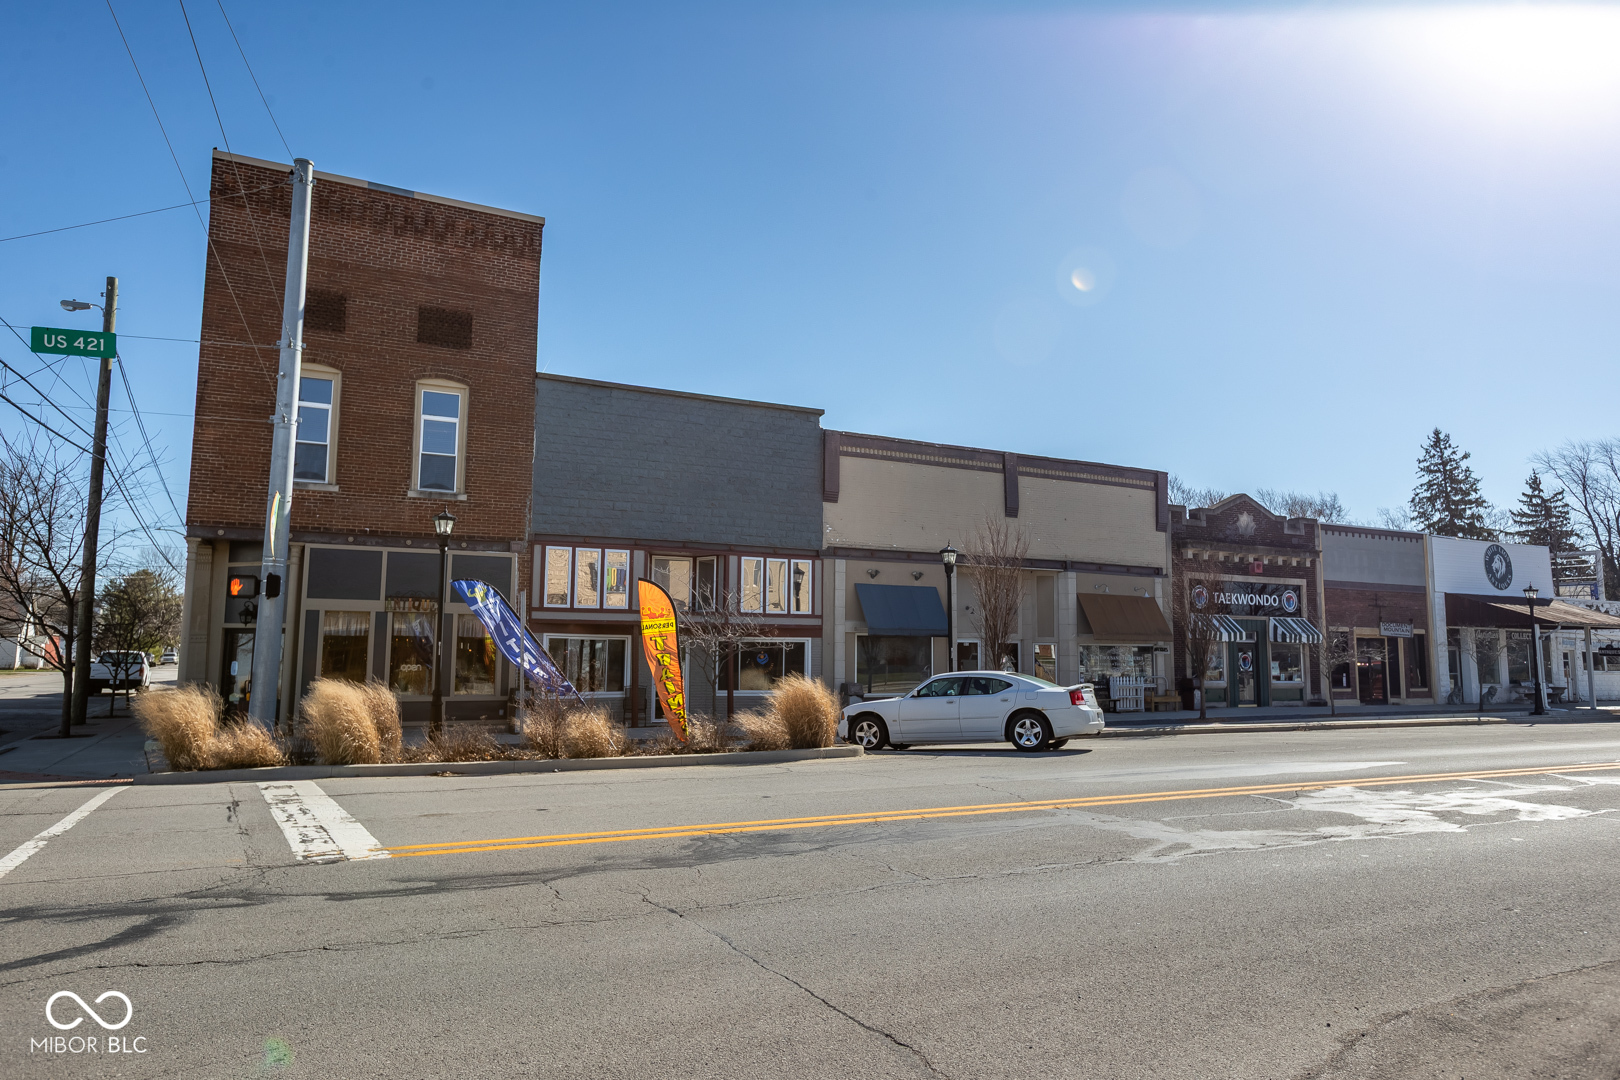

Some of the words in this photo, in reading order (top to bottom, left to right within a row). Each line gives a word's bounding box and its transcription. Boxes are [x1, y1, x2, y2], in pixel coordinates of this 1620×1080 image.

[43, 334, 67, 348] US
[73, 337, 104, 351] 421
[1213, 591, 1279, 606] TAEKWONDO
[1511, 632, 1532, 640] COLLECT
[400, 664, 422, 672] open
